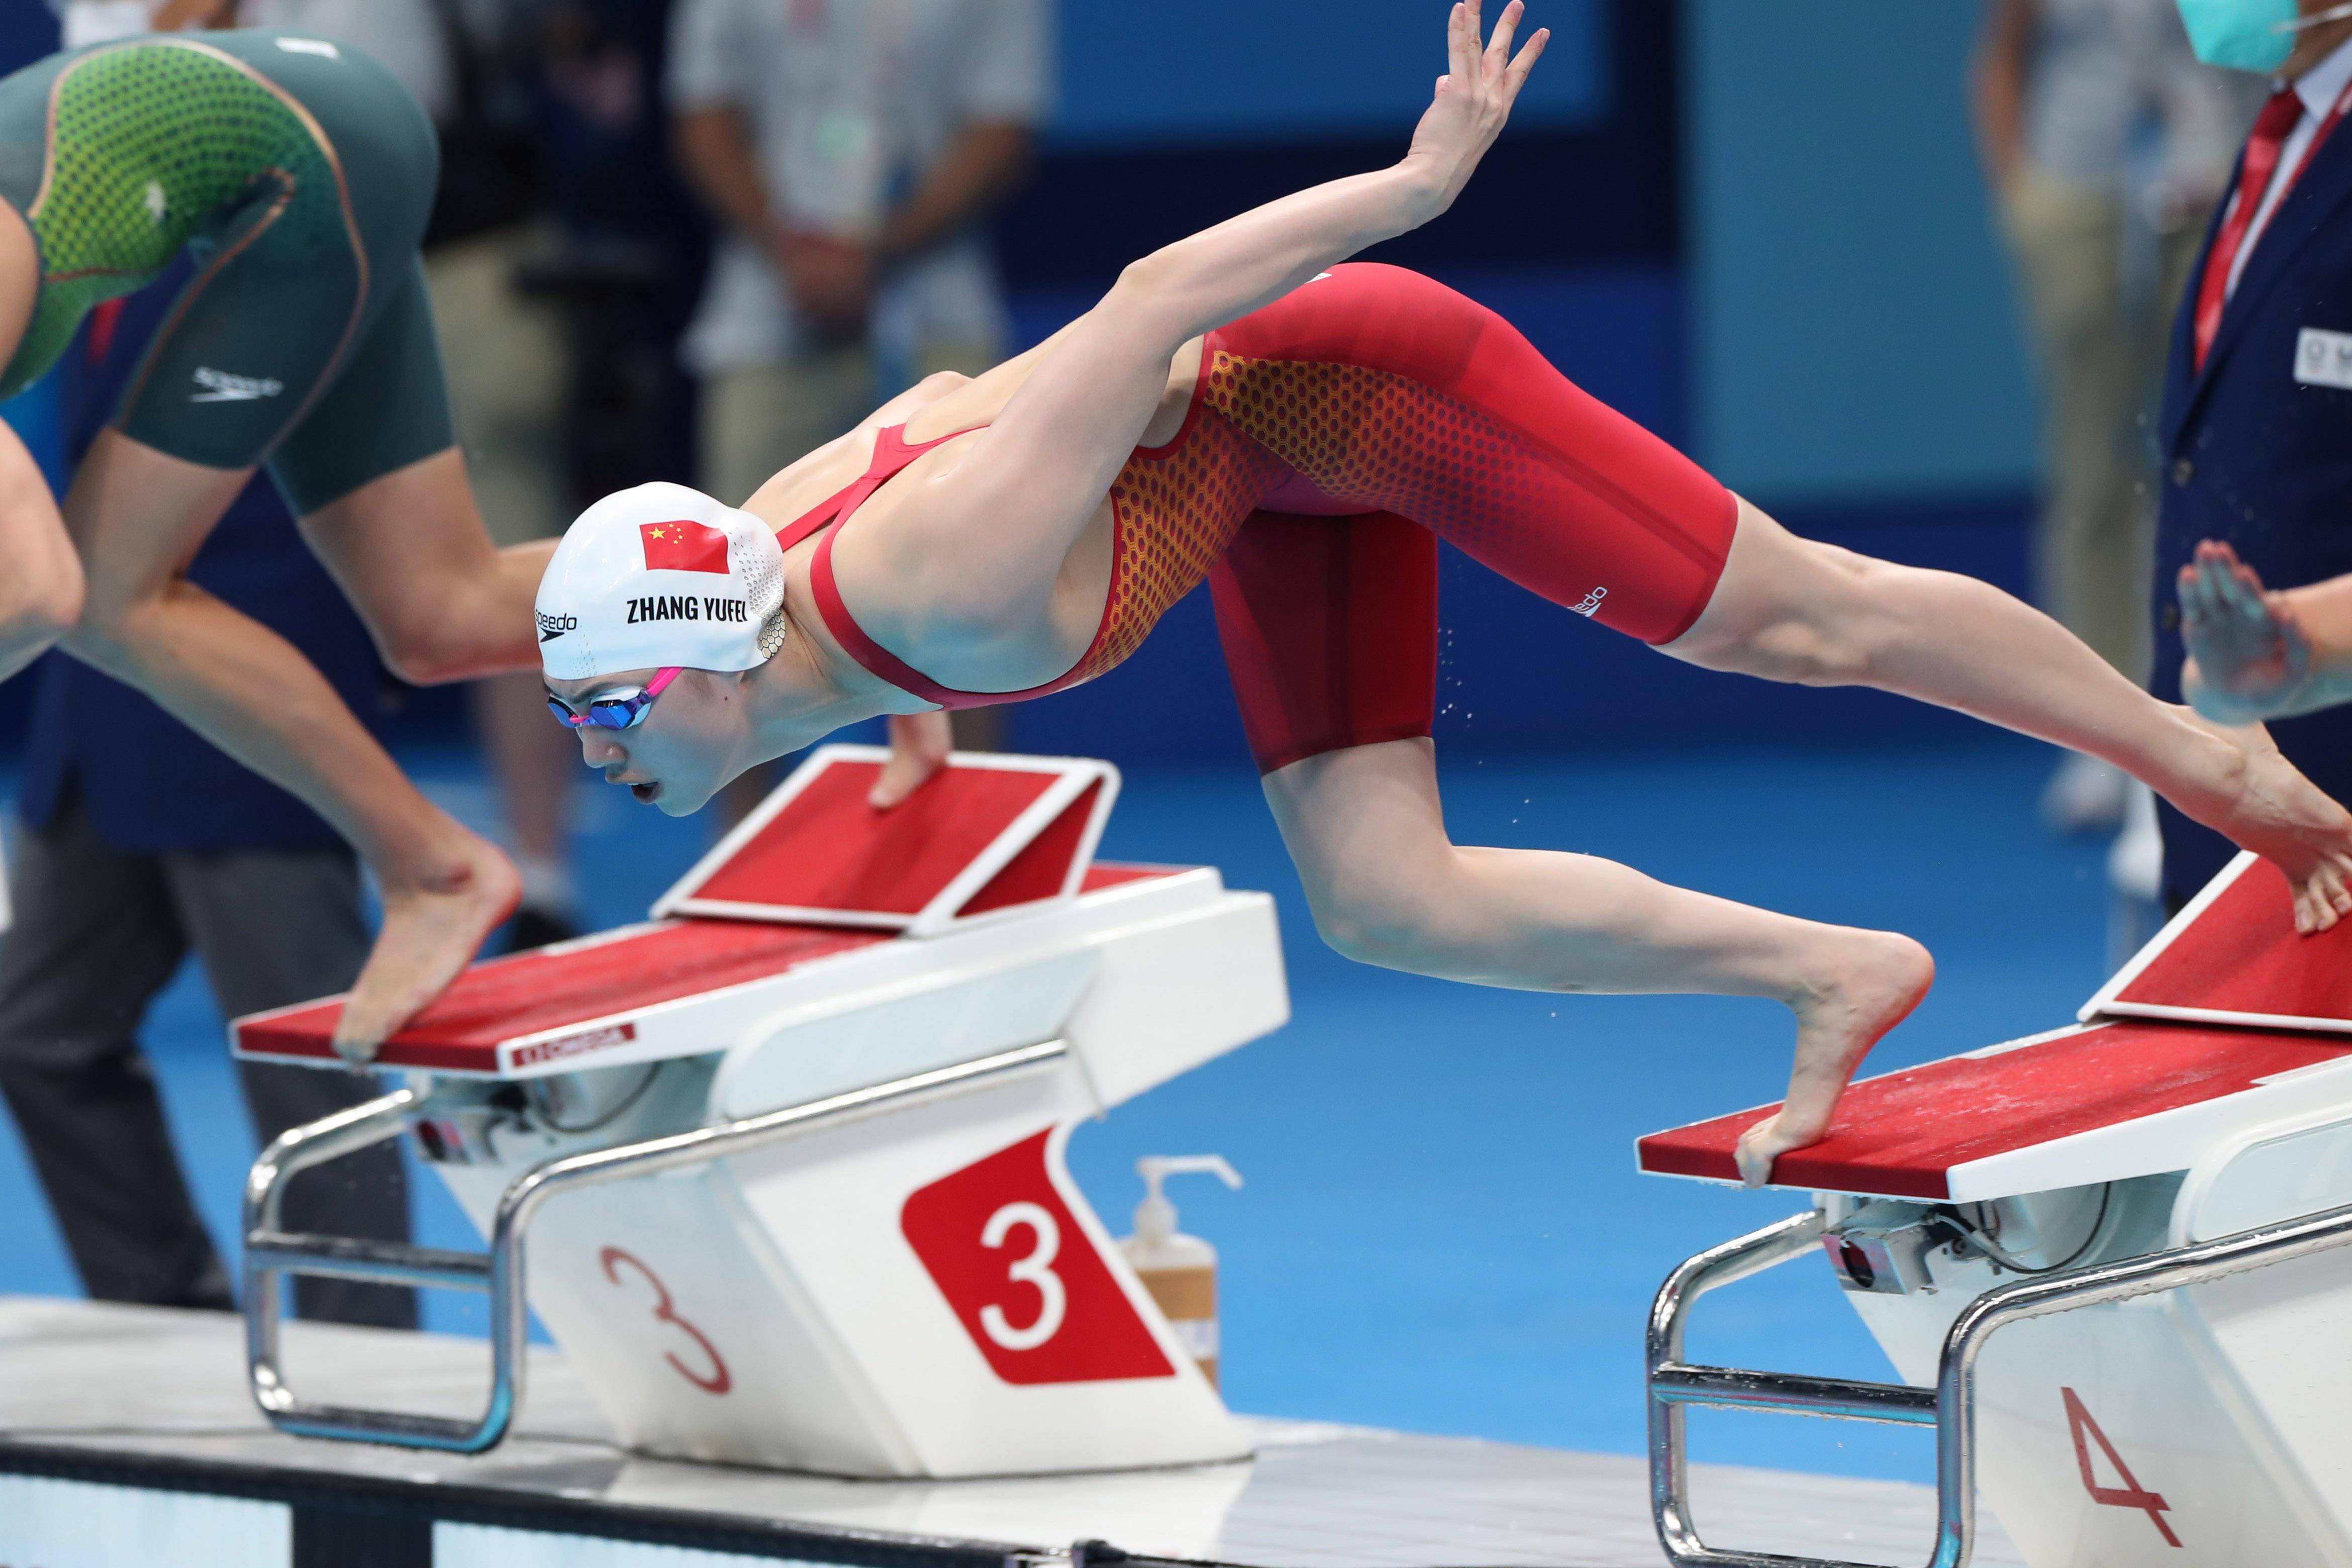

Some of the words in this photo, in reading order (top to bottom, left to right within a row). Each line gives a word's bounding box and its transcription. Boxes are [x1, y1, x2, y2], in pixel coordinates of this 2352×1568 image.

[627, 596, 699, 624] ZHANG
[1566, 586, 1608, 613] edo
[598, 1246, 731, 1395] 3
[979, 1201, 1066, 1350] 3
[2060, 1386, 2185, 1548] 4
